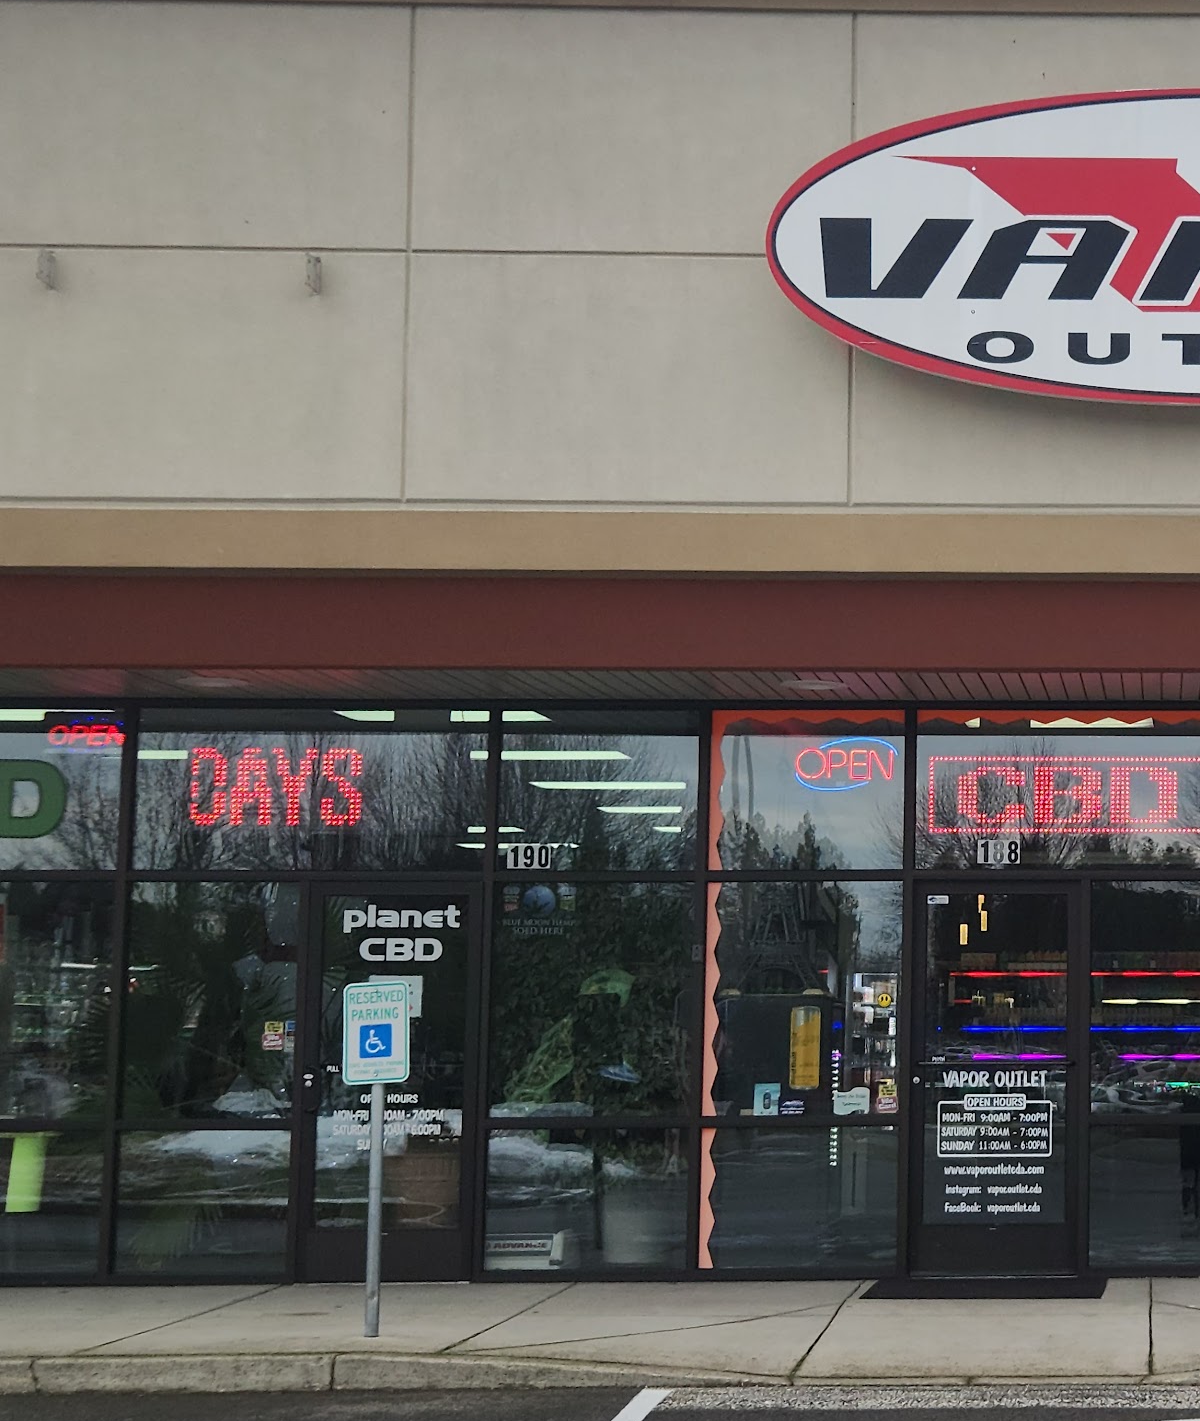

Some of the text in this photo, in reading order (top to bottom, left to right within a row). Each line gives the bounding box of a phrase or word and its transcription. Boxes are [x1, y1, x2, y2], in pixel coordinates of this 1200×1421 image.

[47, 724, 126, 746] OPEN
[794, 747, 894, 781] OPEN
[189, 746, 364, 827] DAYS
[956, 765, 1179, 824] CBD
[510, 845, 549, 868] 190
[980, 840, 1019, 864] 188
[342, 904, 461, 934] planet
[358, 937, 443, 962] CBD
[349, 989, 404, 1005] RESERVED
[351, 1006, 400, 1021] PARKING
[326, 1065, 340, 1073] PULL
[942, 1069, 1048, 1088] VAPOR OUTLET
[387, 1094, 419, 1104] HOURS
[967, 1097, 1024, 1107] OPEN HOURS
[333, 1109, 370, 1121] MON-FRI
[942, 1112, 976, 1123] MON-FRI
[980, 1112, 1011, 1123] 9:00AM
[1019, 1112, 1048, 1122] 7:00PM
[941, 1126, 978, 1137] SATURDAY
[979, 1126, 1011, 1137] 9:00AM
[1020, 1127, 1048, 1137] 7:00PM
[940, 1140, 976, 1151] SUNDAY
[979, 1140, 1012, 1150] 11:00AM
[1020, 1140, 1048, 1150] 6:00PM
[943, 1162, 1045, 1179] www.vaporoutletcda.com
